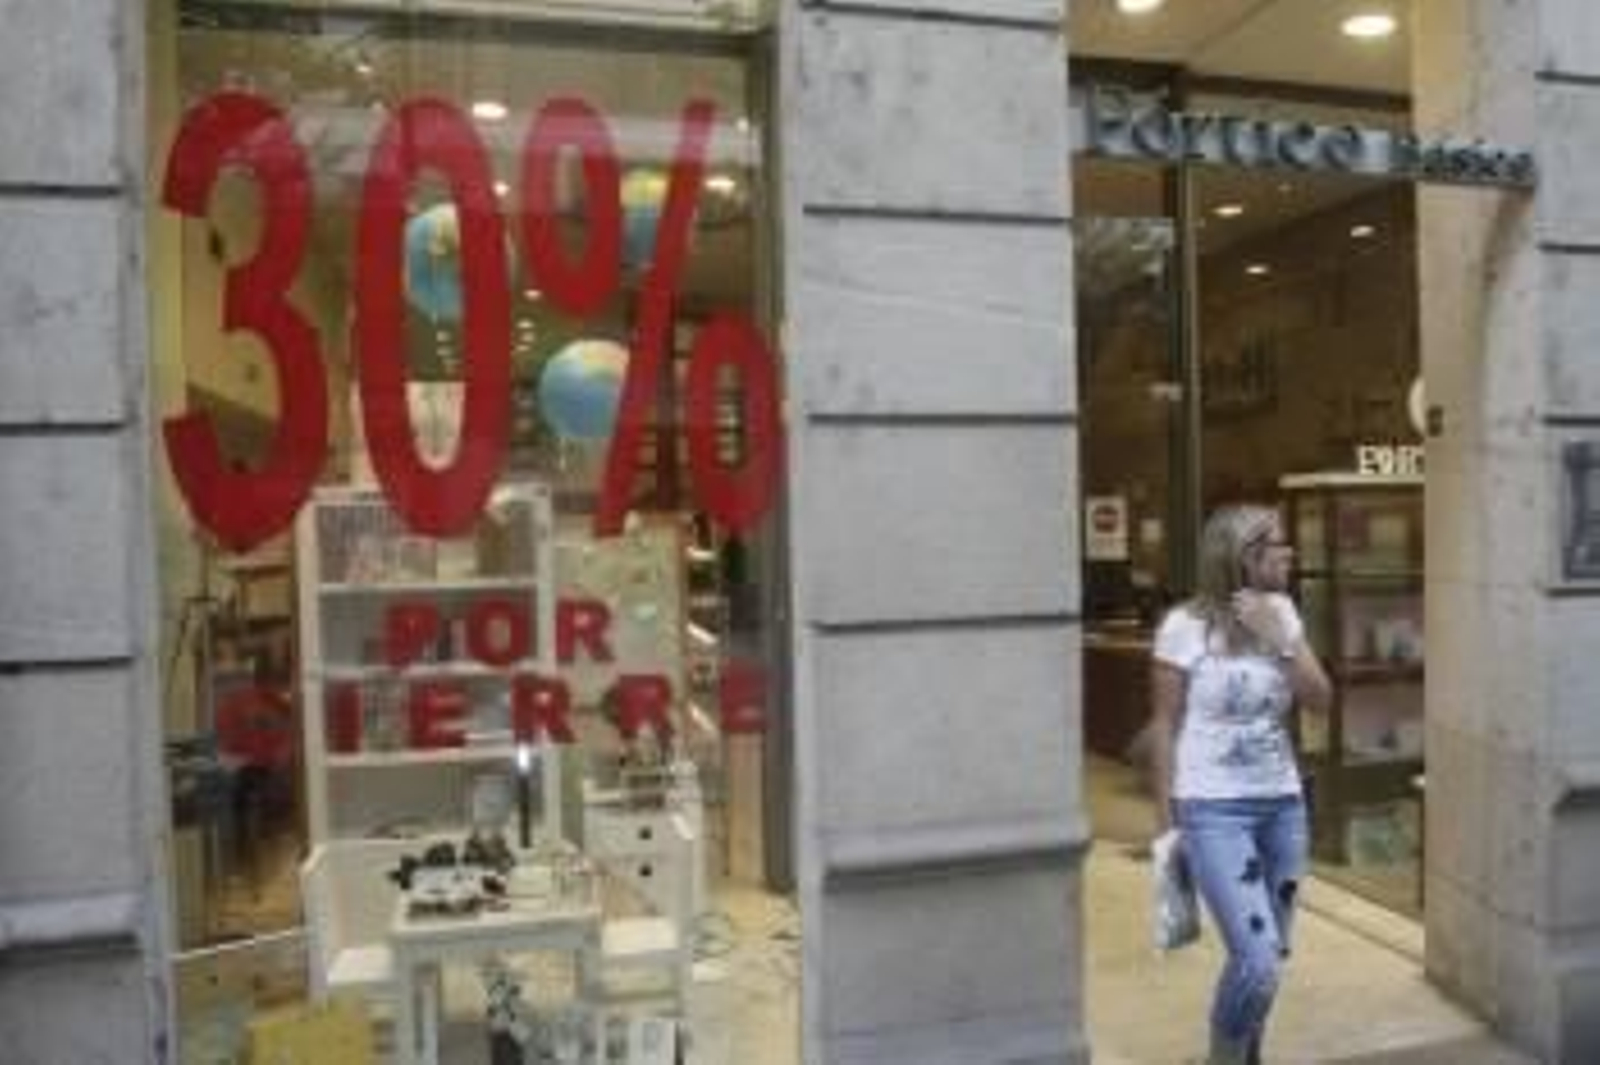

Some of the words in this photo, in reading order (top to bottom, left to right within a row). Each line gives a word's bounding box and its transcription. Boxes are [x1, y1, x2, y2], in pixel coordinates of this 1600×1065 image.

[162, 90, 787, 553] 30%
[381, 596, 613, 669] POR
[216, 658, 767, 762] CIERRE
